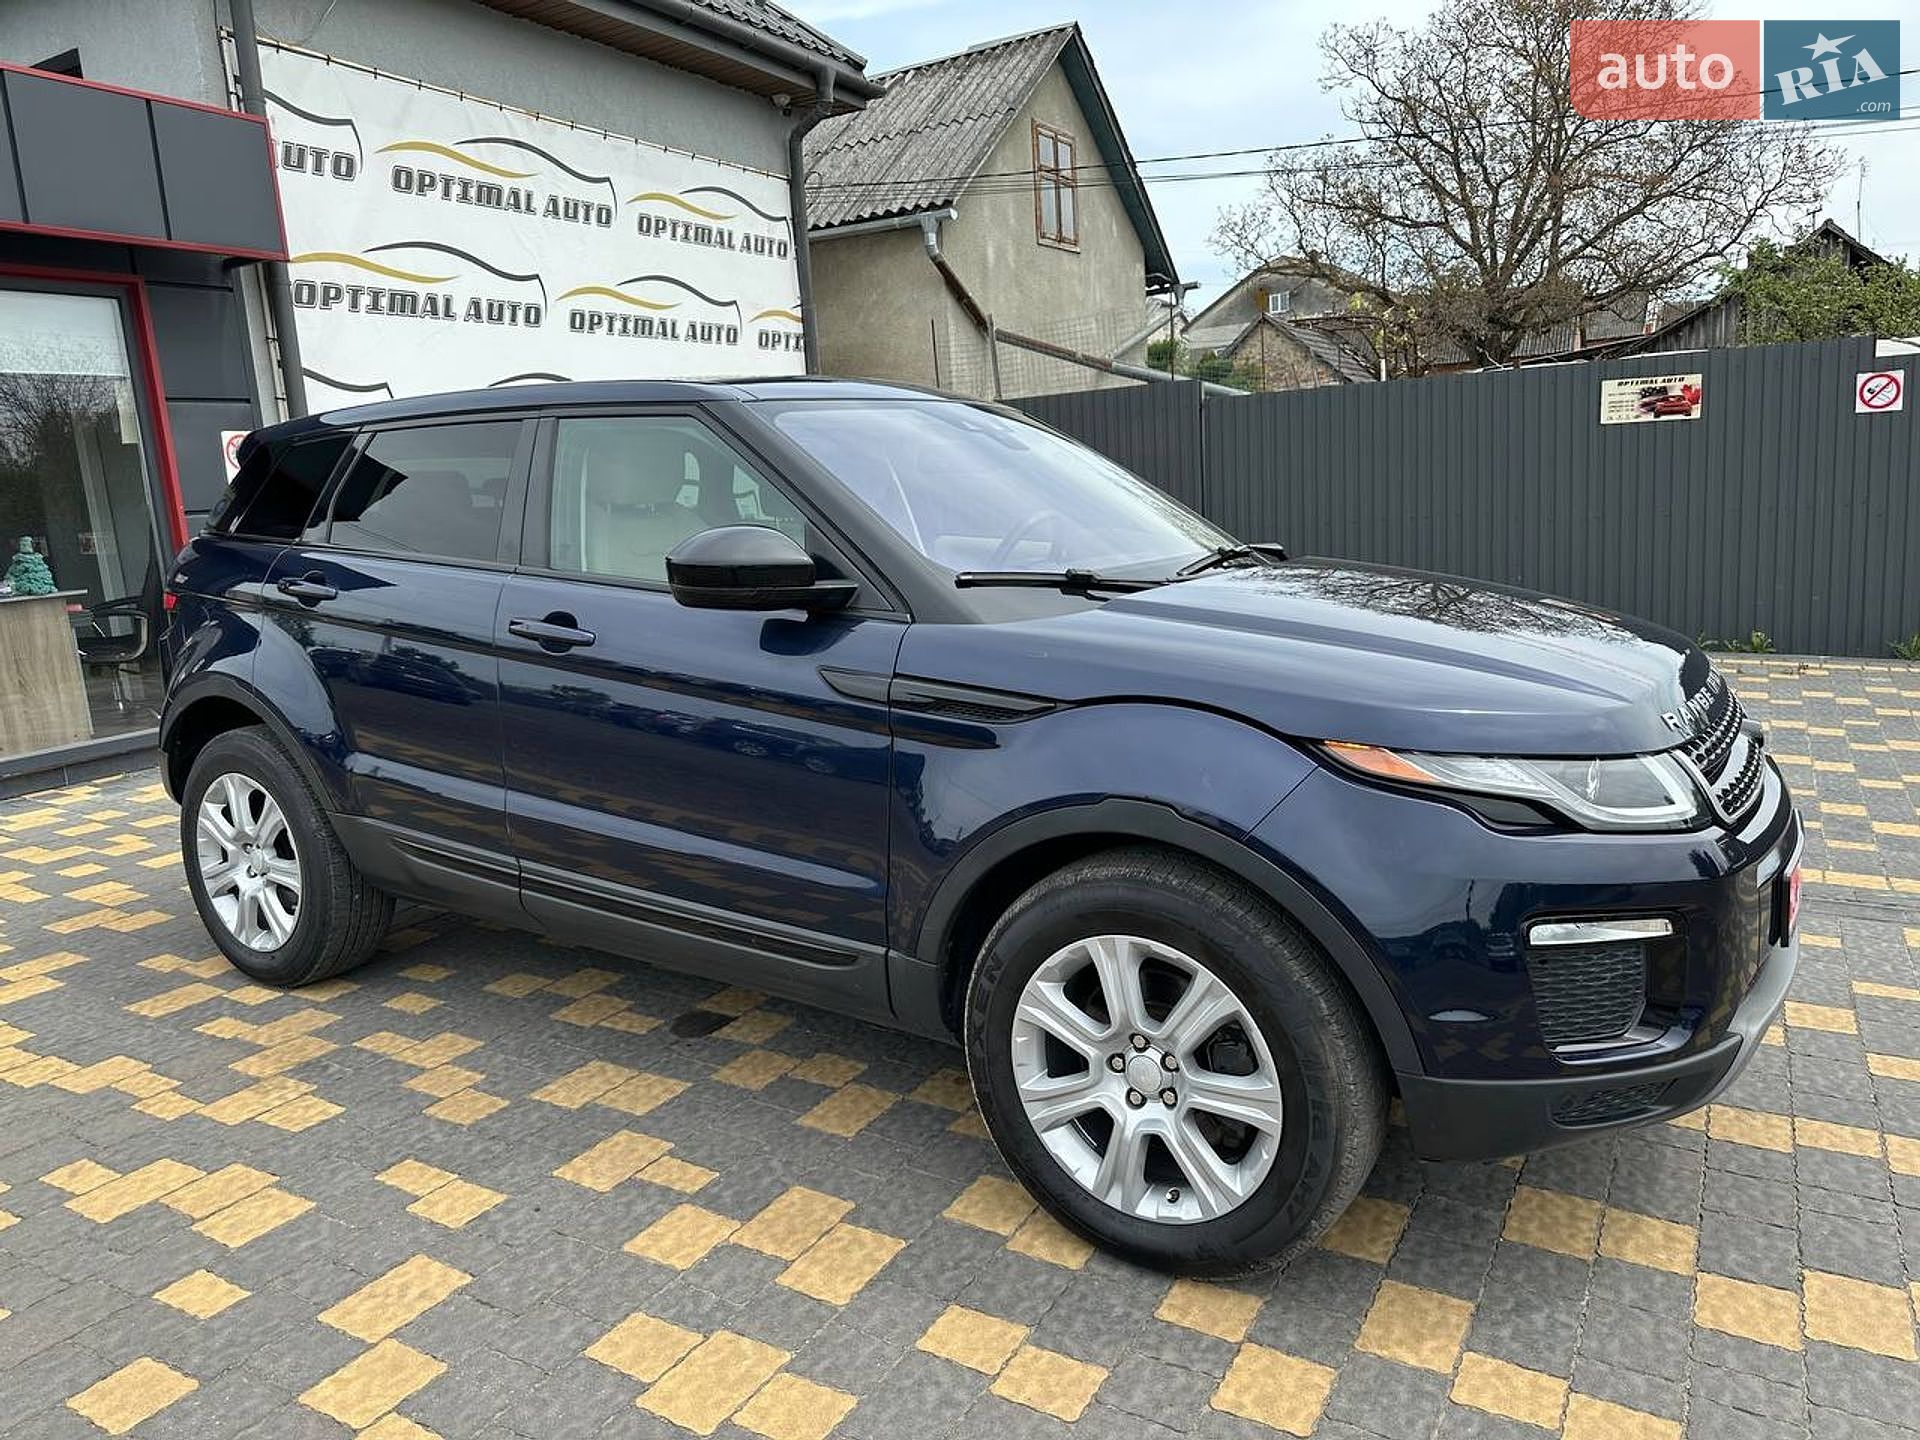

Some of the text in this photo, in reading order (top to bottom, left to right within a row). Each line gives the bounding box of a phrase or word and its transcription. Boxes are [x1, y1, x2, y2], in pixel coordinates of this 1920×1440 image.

[277, 141, 357, 182] UTO
[391, 164, 612, 228] OPTIMAL AUTO
[637, 213, 789, 260] OPTIMAL AUTO
[293, 278, 542, 328] OPTIMAL AUTO
[569, 309, 739, 346] OPTIMAL AUTO
